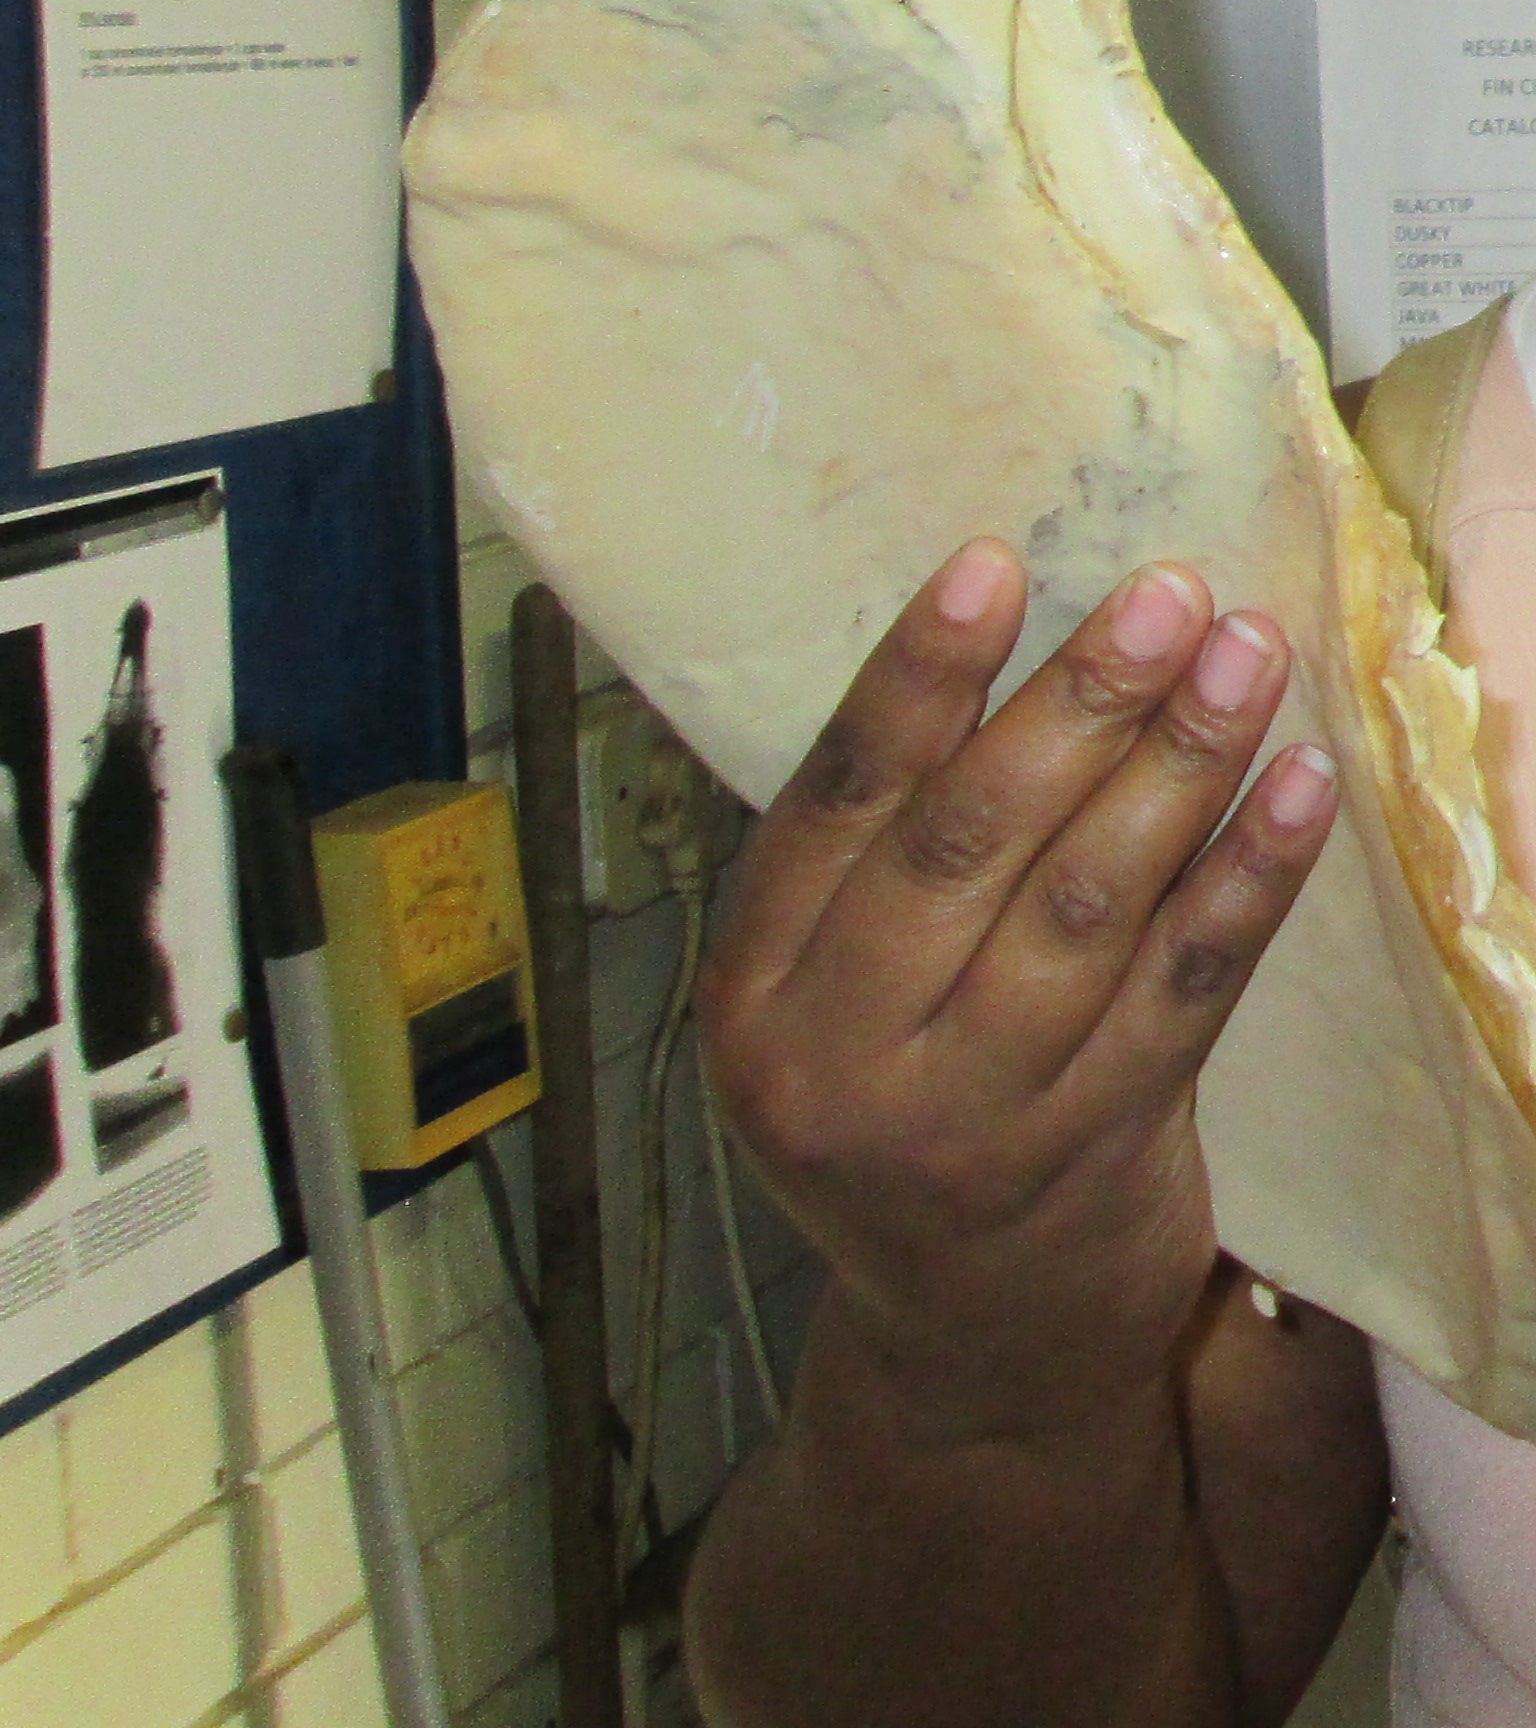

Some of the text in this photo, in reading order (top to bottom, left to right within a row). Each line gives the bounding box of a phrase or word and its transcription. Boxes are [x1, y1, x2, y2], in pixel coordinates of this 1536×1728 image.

[1483, 79, 1513, 95] FIN
[1393, 197, 1474, 214] BLACKTIP
[1395, 226, 1451, 242] DUSKY
[1396, 253, 1463, 269] COPPER
[1398, 281, 1452, 297] GREAT
[1399, 309, 1440, 323] JAVA
